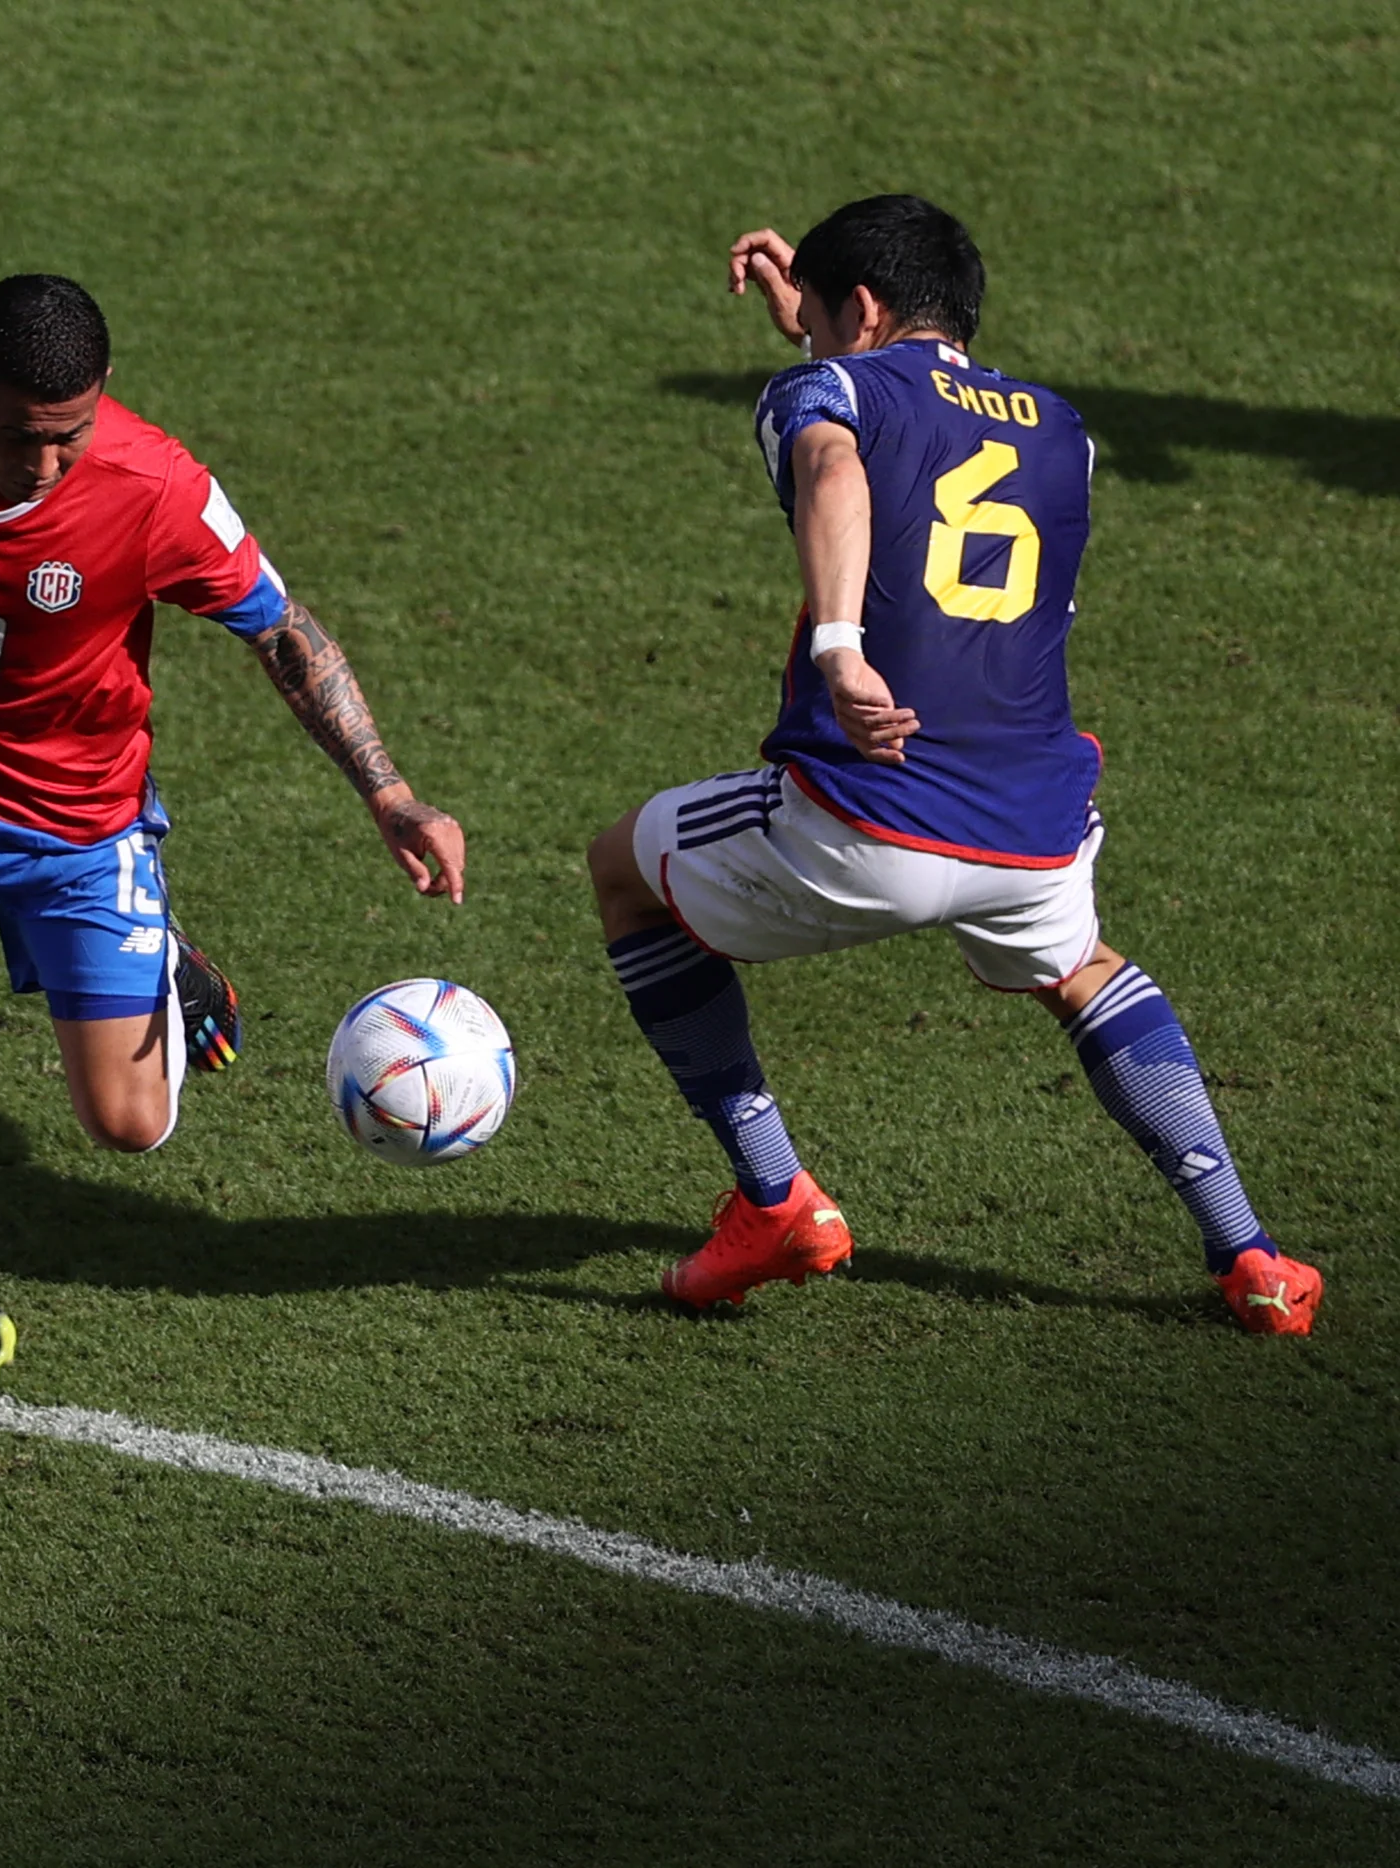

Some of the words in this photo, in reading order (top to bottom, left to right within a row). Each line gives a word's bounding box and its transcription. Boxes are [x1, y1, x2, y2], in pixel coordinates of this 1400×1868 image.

[929, 369, 1040, 428] ENDO
[923, 440, 1040, 623] 6
[40, 572, 70, 604] CR
